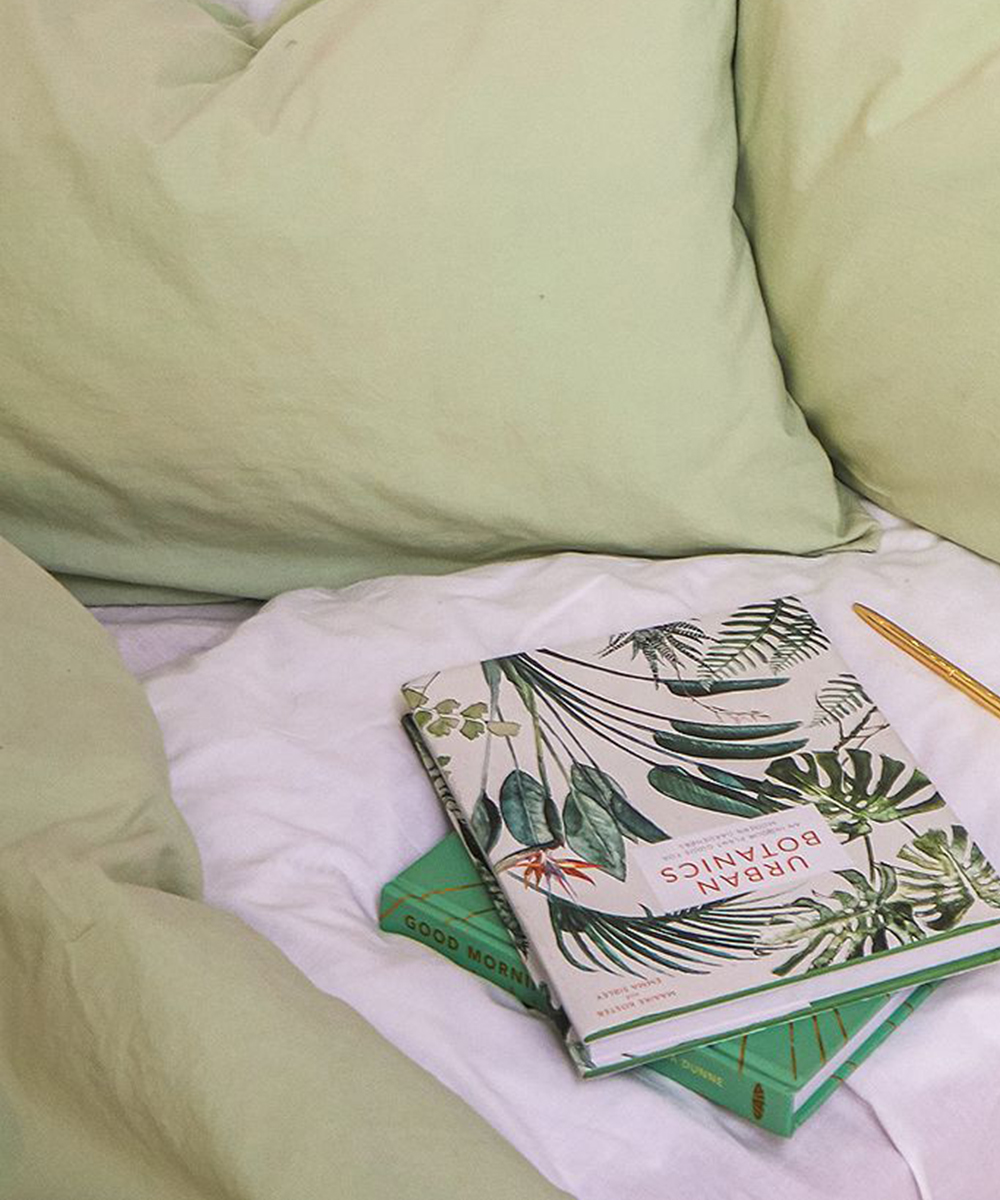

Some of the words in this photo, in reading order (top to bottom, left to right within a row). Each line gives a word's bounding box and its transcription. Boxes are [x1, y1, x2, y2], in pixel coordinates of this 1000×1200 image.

[660, 830, 821, 883] BOTANICS
[697, 855, 809, 896] URBAN
[403, 915, 460, 950] GOOD
[467, 946, 530, 987] MORNI
